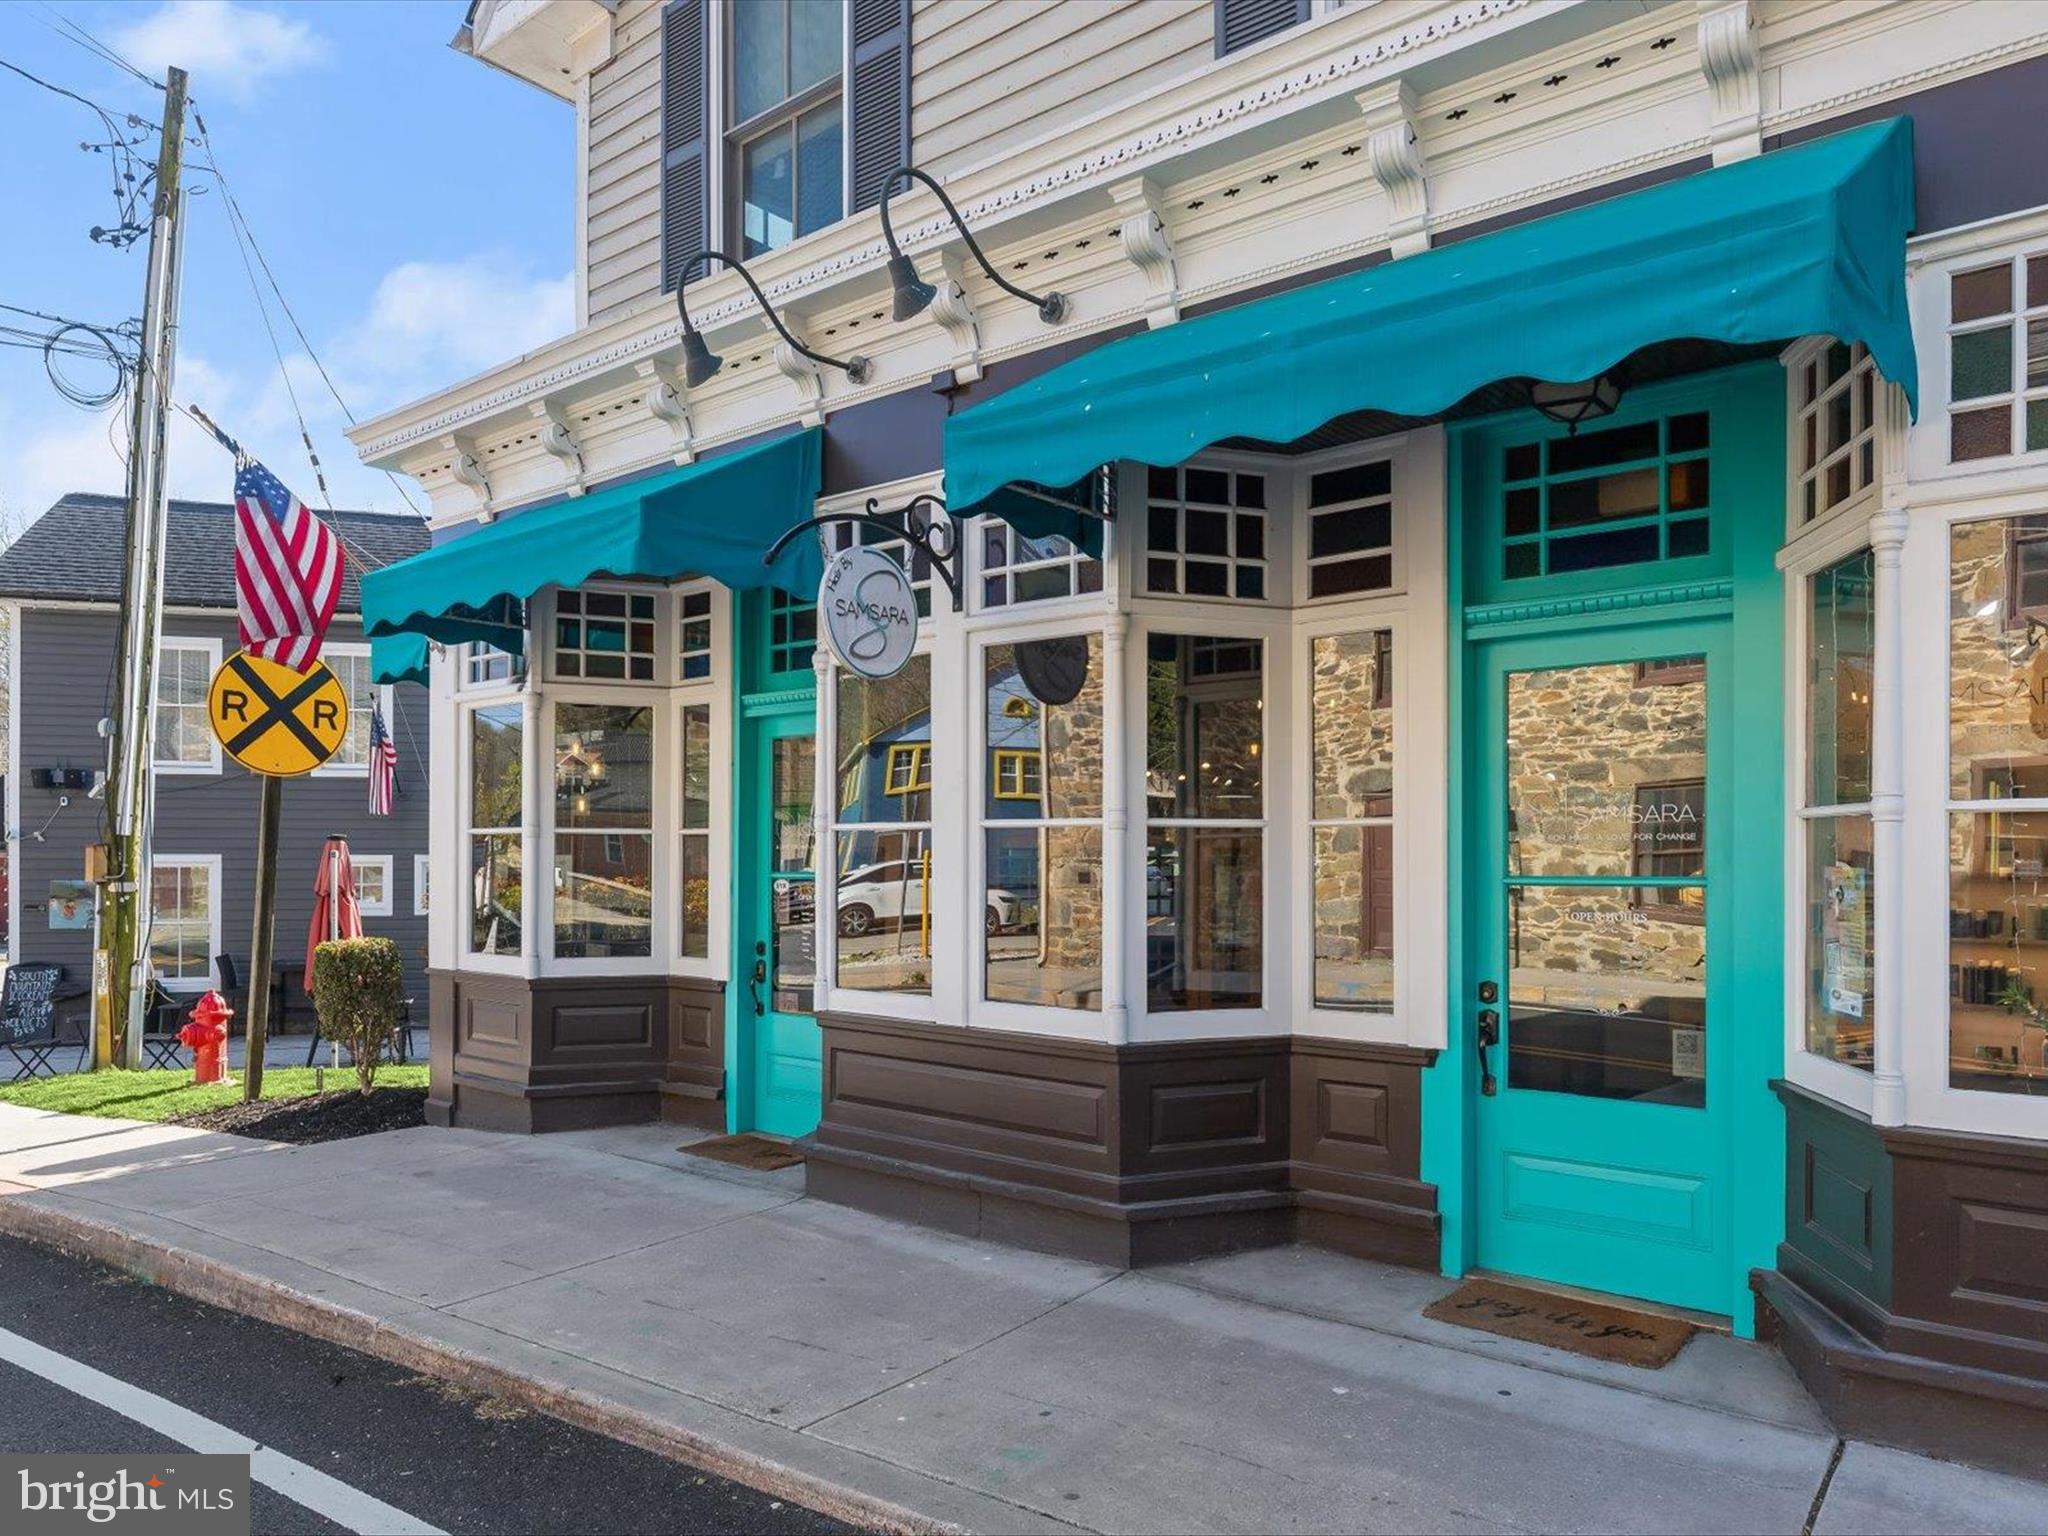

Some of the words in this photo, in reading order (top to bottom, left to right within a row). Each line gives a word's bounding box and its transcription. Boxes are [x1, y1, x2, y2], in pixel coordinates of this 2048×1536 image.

[835, 598, 910, 626] SAMSARA
[221, 689, 249, 722] R
[313, 699, 338, 731] R
[1574, 804, 1697, 823] SAMSARA
[1633, 832, 1653, 841] FOR
[1656, 832, 1697, 841] CHANGE
[1570, 911, 1602, 922] OPEN
[1605, 911, 1648, 923] HOURS
[1584, 1324, 1657, 1342] you
